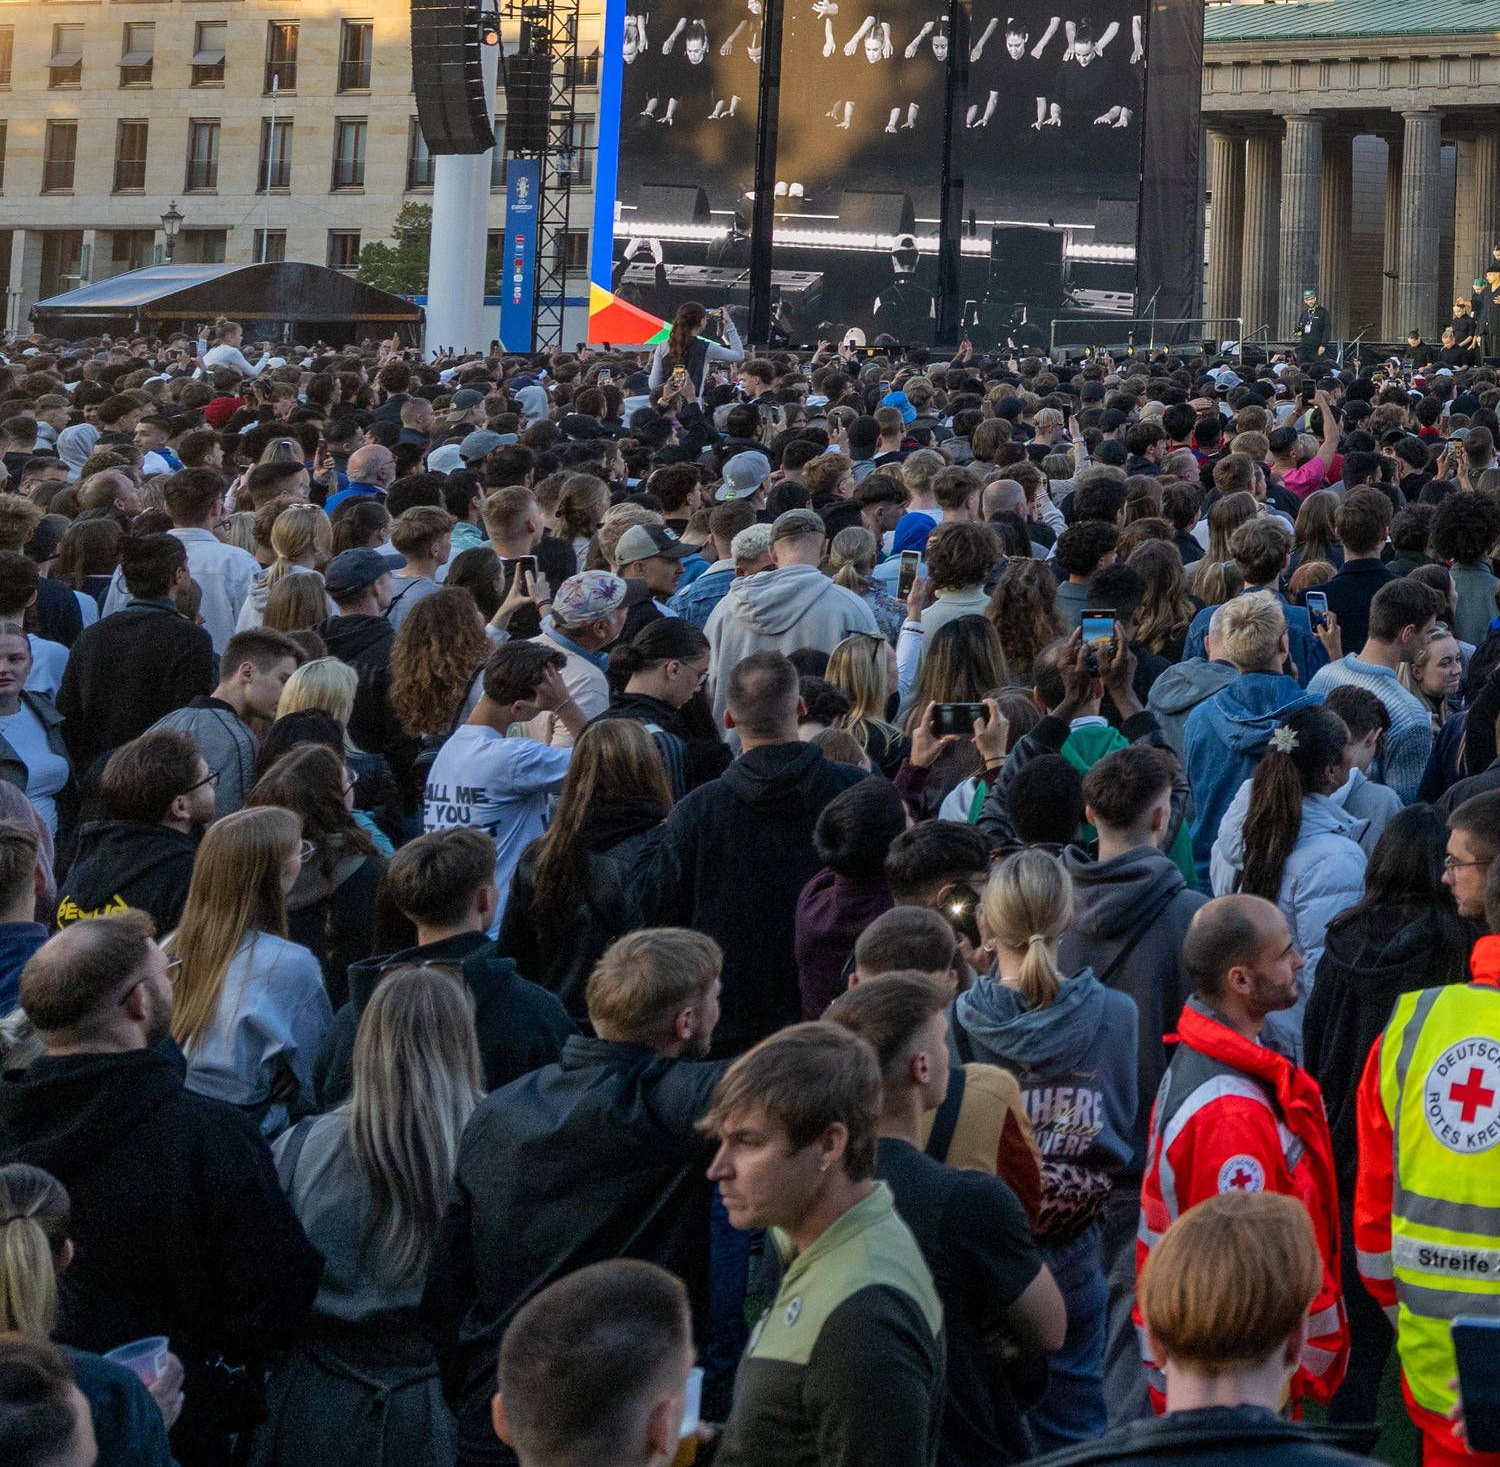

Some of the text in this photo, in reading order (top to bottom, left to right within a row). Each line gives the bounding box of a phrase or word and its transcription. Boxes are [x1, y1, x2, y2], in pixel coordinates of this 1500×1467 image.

[424, 783, 491, 804] ALL ME
[436, 805, 471, 824] YOU
[1429, 1092, 1461, 1145] ROTES
[1418, 1248, 1489, 1273] Streife
